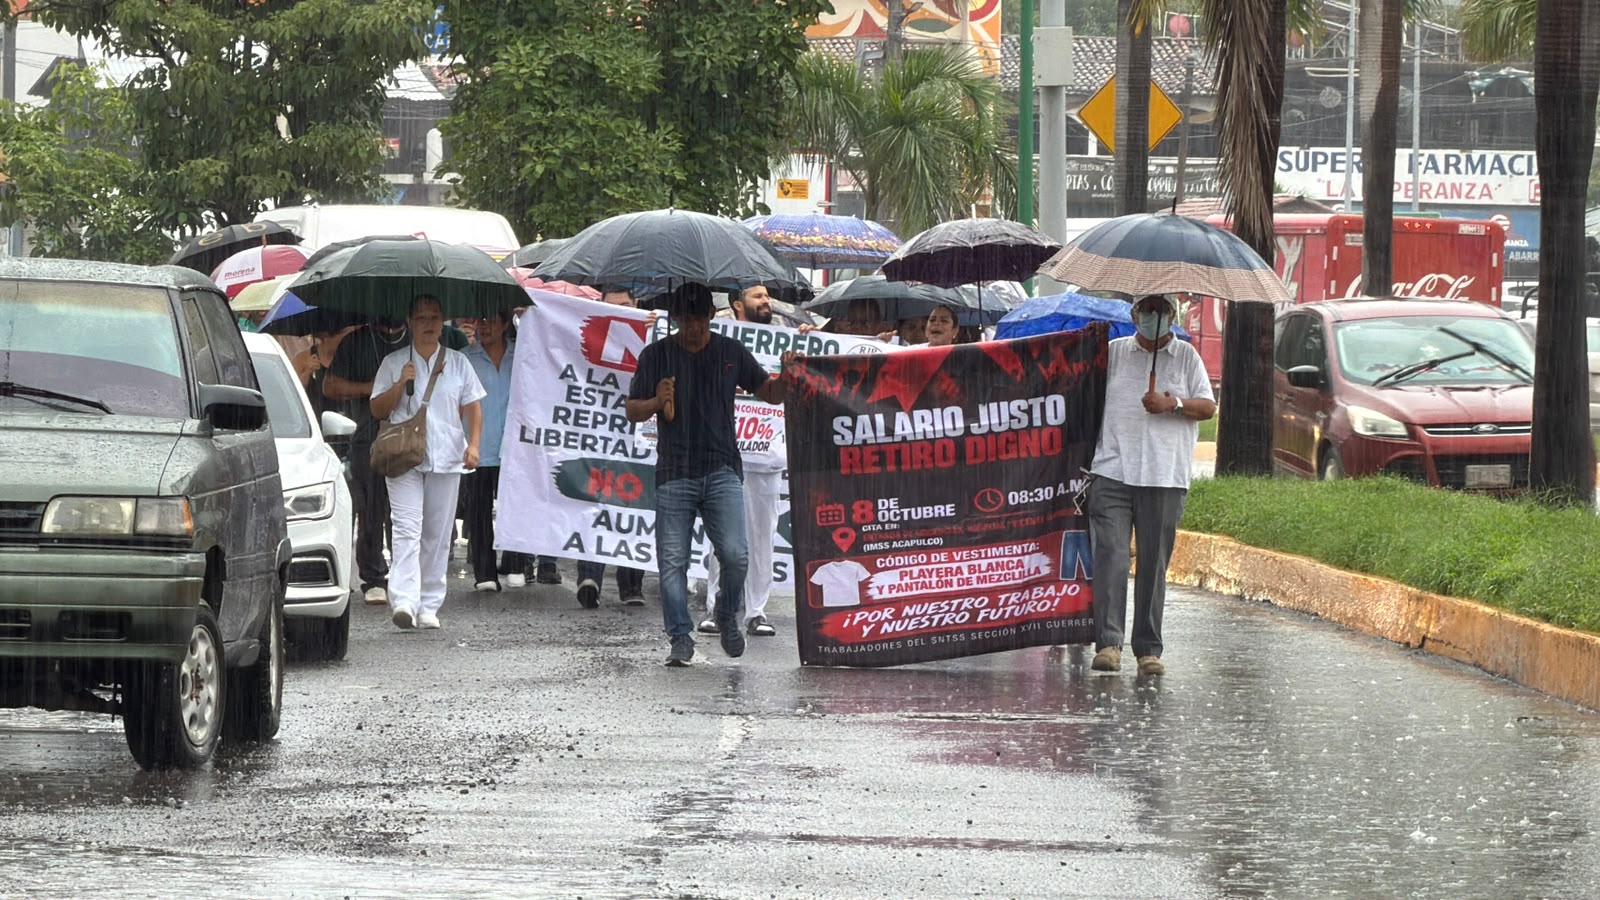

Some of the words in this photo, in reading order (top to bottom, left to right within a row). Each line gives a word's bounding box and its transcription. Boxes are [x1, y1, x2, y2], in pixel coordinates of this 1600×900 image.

[1278, 150, 1363, 173] SUPER
[1407, 153, 1539, 176] FARMACI
[225, 267, 256, 278] morena
[558, 363, 578, 382] A
[586, 367, 620, 390] LA
[565, 384, 628, 410] ESTA
[736, 416, 774, 441] 10%
[833, 406, 965, 446] SALARIO
[970, 394, 1067, 435] JUSTO
[737, 440, 770, 452] ULADOR
[840, 438, 957, 476] RETIRO
[965, 427, 1063, 466] DIGNO
[587, 466, 644, 502] NO
[1008, 486, 1054, 506] 08:30
[852, 499, 875, 525] 8
[878, 498, 899, 510] DE
[878, 504, 956, 522] OCTUBRE
[862, 524, 882, 532] CITA
[884, 523, 900, 531] EN:
[562, 531, 586, 554] A
[595, 535, 653, 563] LAS
[863, 542, 890, 553] (IMSS
[892, 537, 944, 549] ACAPULCO)
[876, 553, 927, 569] CÓDIGO
[931, 552, 949, 563] DE
[952, 543, 1040, 562] VESTIMENTA:
[876, 586, 885, 595] Y
[888, 577, 954, 593] PANTALÓN
[957, 578, 973, 587] DE
[976, 566, 1042, 585] MEZCLILLA
[900, 565, 965, 581] PLAYERA
[967, 559, 1025, 574] BLANCA
[843, 608, 896, 628] ¡POR
[902, 597, 989, 617] NUESTRO
[998, 584, 1081, 606] TRABAJO
[862, 624, 875, 638] Y
[880, 612, 970, 634] NUESTRO
[976, 598, 1061, 622] FUTURO!
[818, 641, 902, 654] TRABAJADORES
[907, 638, 926, 647] DEL
[931, 633, 966, 644] SNTSS
[970, 627, 1016, 640] SECCIÓN
[1020, 622, 1041, 633] XVII
[1046, 618, 1095, 630] GUERRER
